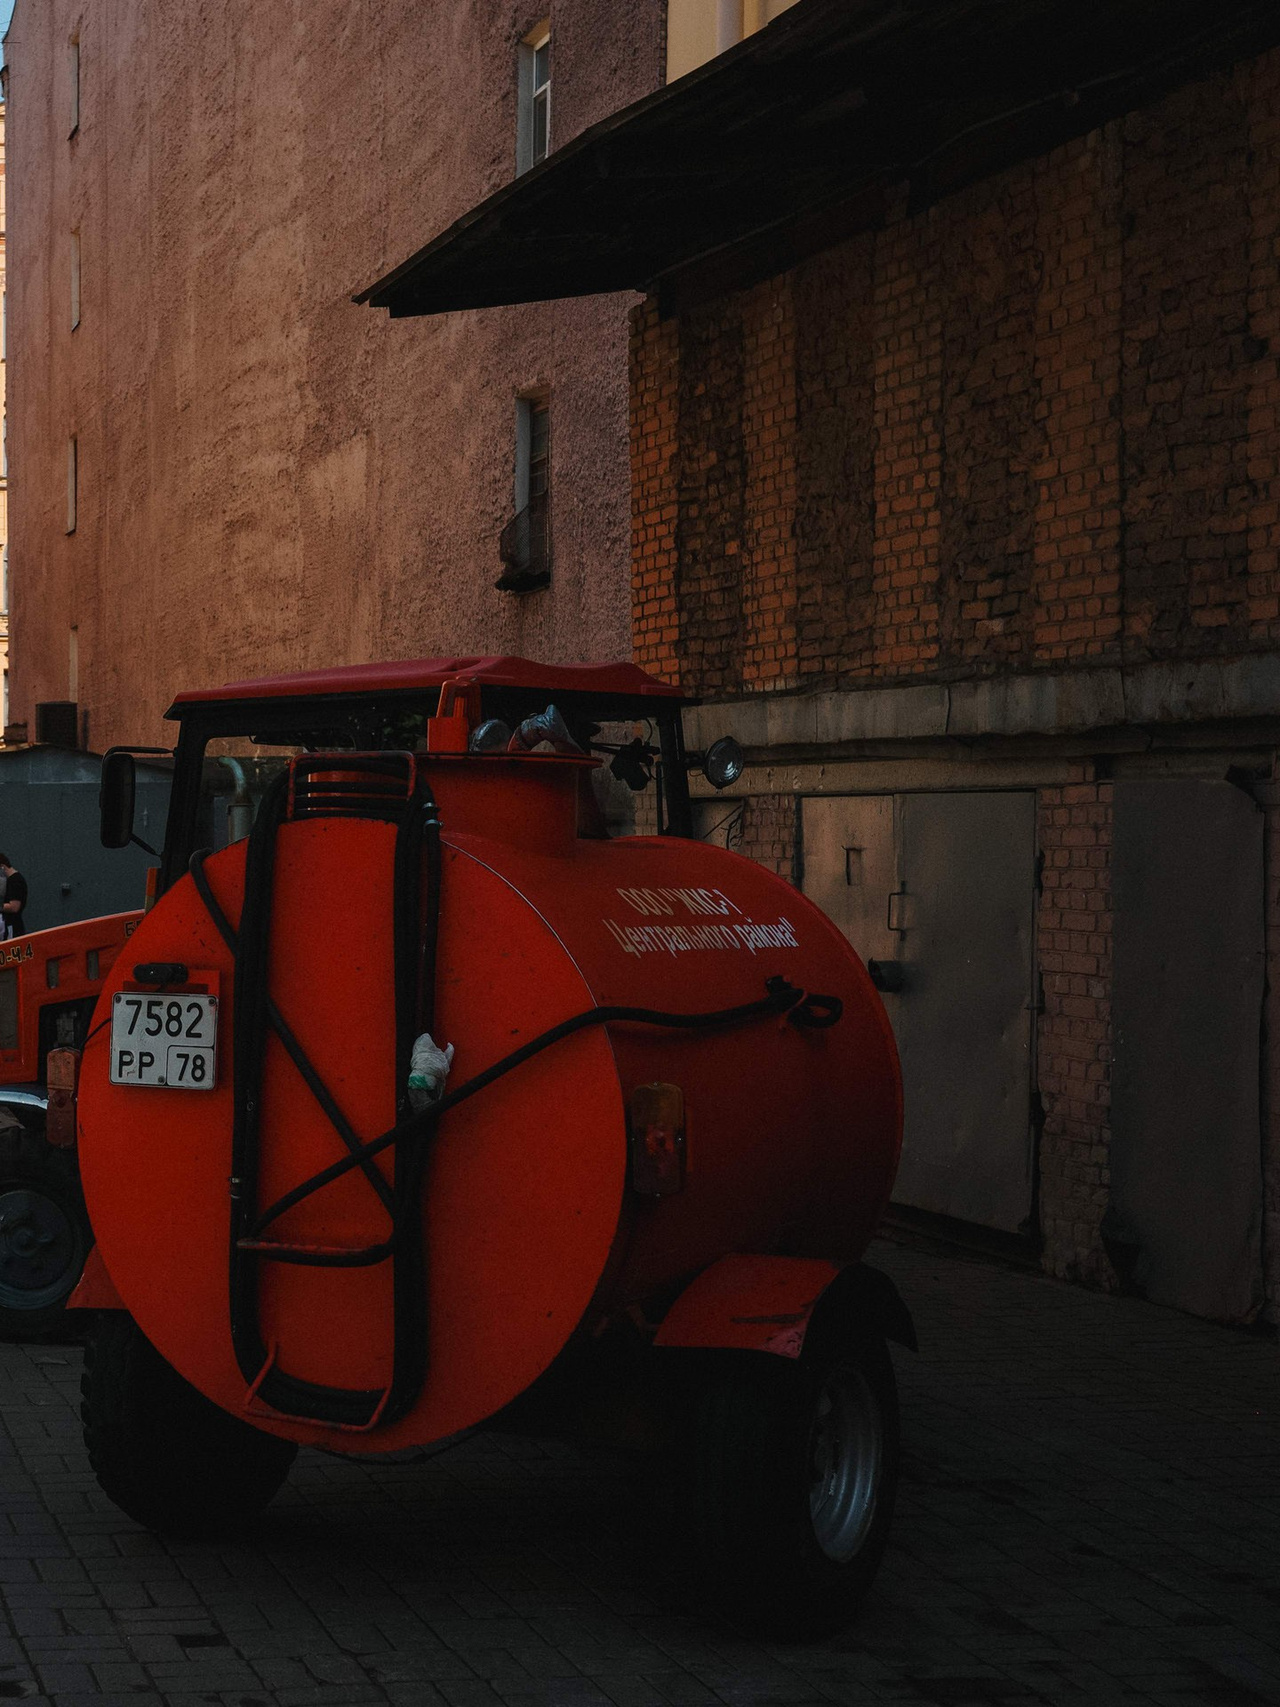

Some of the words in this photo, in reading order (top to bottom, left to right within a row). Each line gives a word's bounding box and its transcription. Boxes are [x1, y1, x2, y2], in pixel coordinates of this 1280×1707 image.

[616, 888, 675, 916] ООО
[602, 918, 741, 959] Центрального
[124, 999, 205, 1039] 7582
[118, 1050, 156, 1079] РР
[176, 1053, 206, 1082] 78
